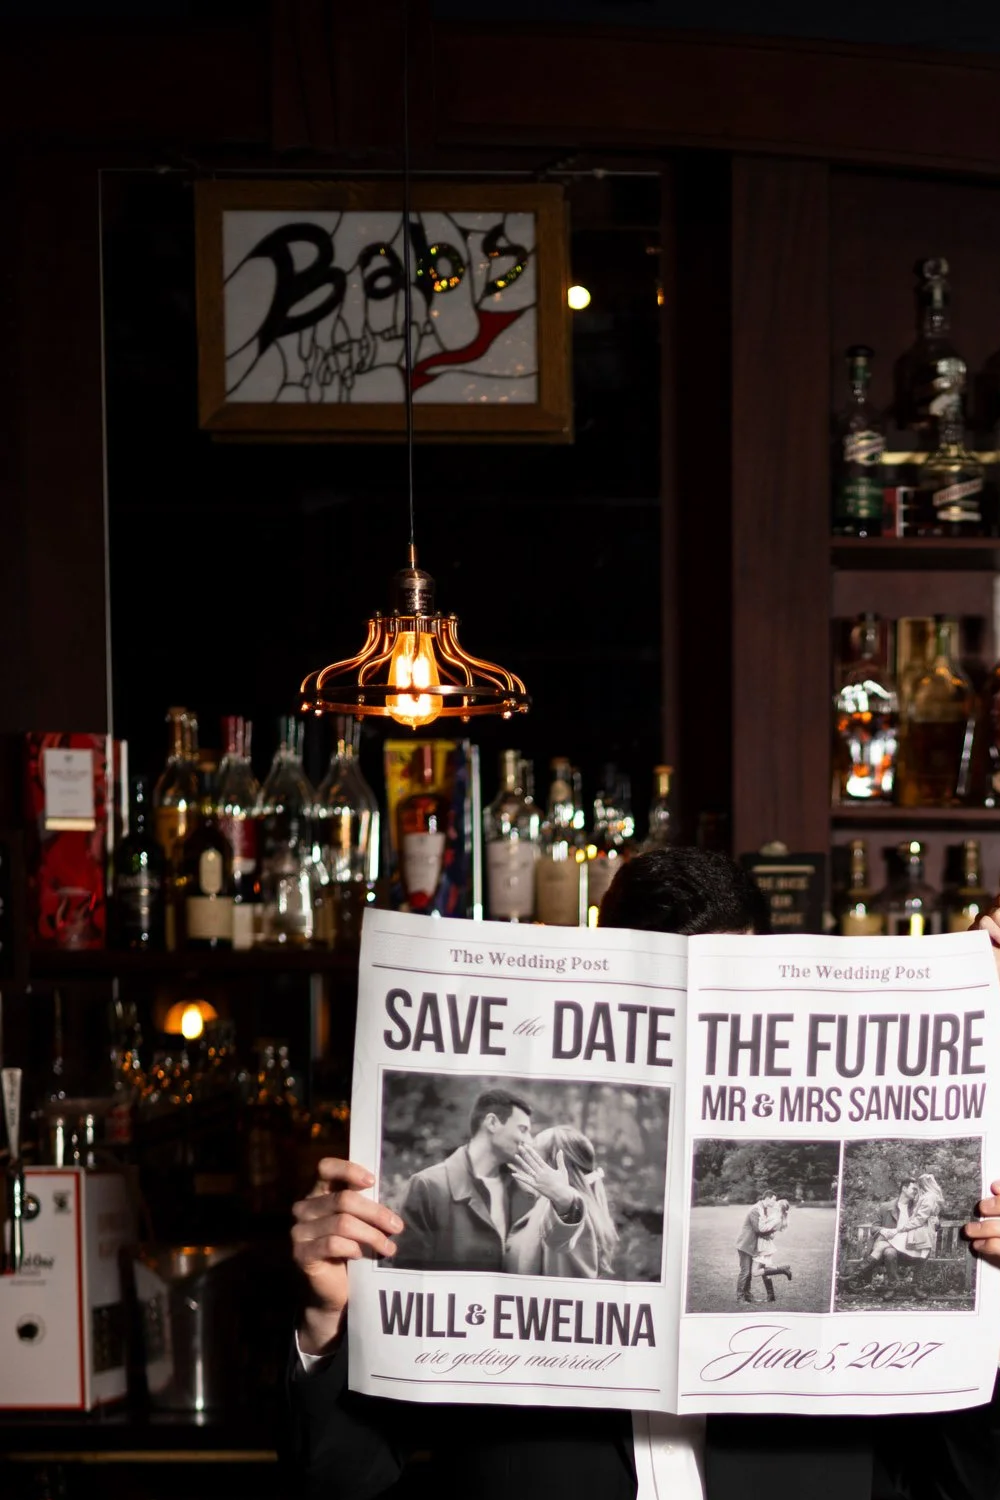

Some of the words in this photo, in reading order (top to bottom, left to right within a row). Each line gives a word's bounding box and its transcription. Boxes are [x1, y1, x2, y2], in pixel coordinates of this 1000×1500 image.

[450, 948, 484, 966] The
[487, 951, 567, 973] Wedding
[571, 957, 609, 971] Post
[779, 964, 810, 978] The
[816, 965, 890, 982] Wedding
[895, 966, 930, 979] Post
[384, 988, 507, 1056] SAVE
[513, 1017, 545, 1036] the
[552, 1001, 675, 1067] DATE
[698, 1013, 794, 1076] THE
[807, 1010, 985, 1078] FUTURE
[702, 1085, 746, 1121] MR
[752, 1094, 774, 1117] &
[780, 1087, 842, 1122] MRS
[848, 1083, 986, 1122] SANISLOW
[379, 1290, 466, 1338] WILL
[465, 1304, 486, 1325] &
[493, 1295, 656, 1347] EWELINA
[414, 1349, 450, 1365] are
[431, 1348, 521, 1376] getting
[524, 1352, 622, 1371] married!
[700, 1324, 820, 1382] June
[815, 1342, 849, 1373] 5,
[845, 1341, 945, 1370] 2027
